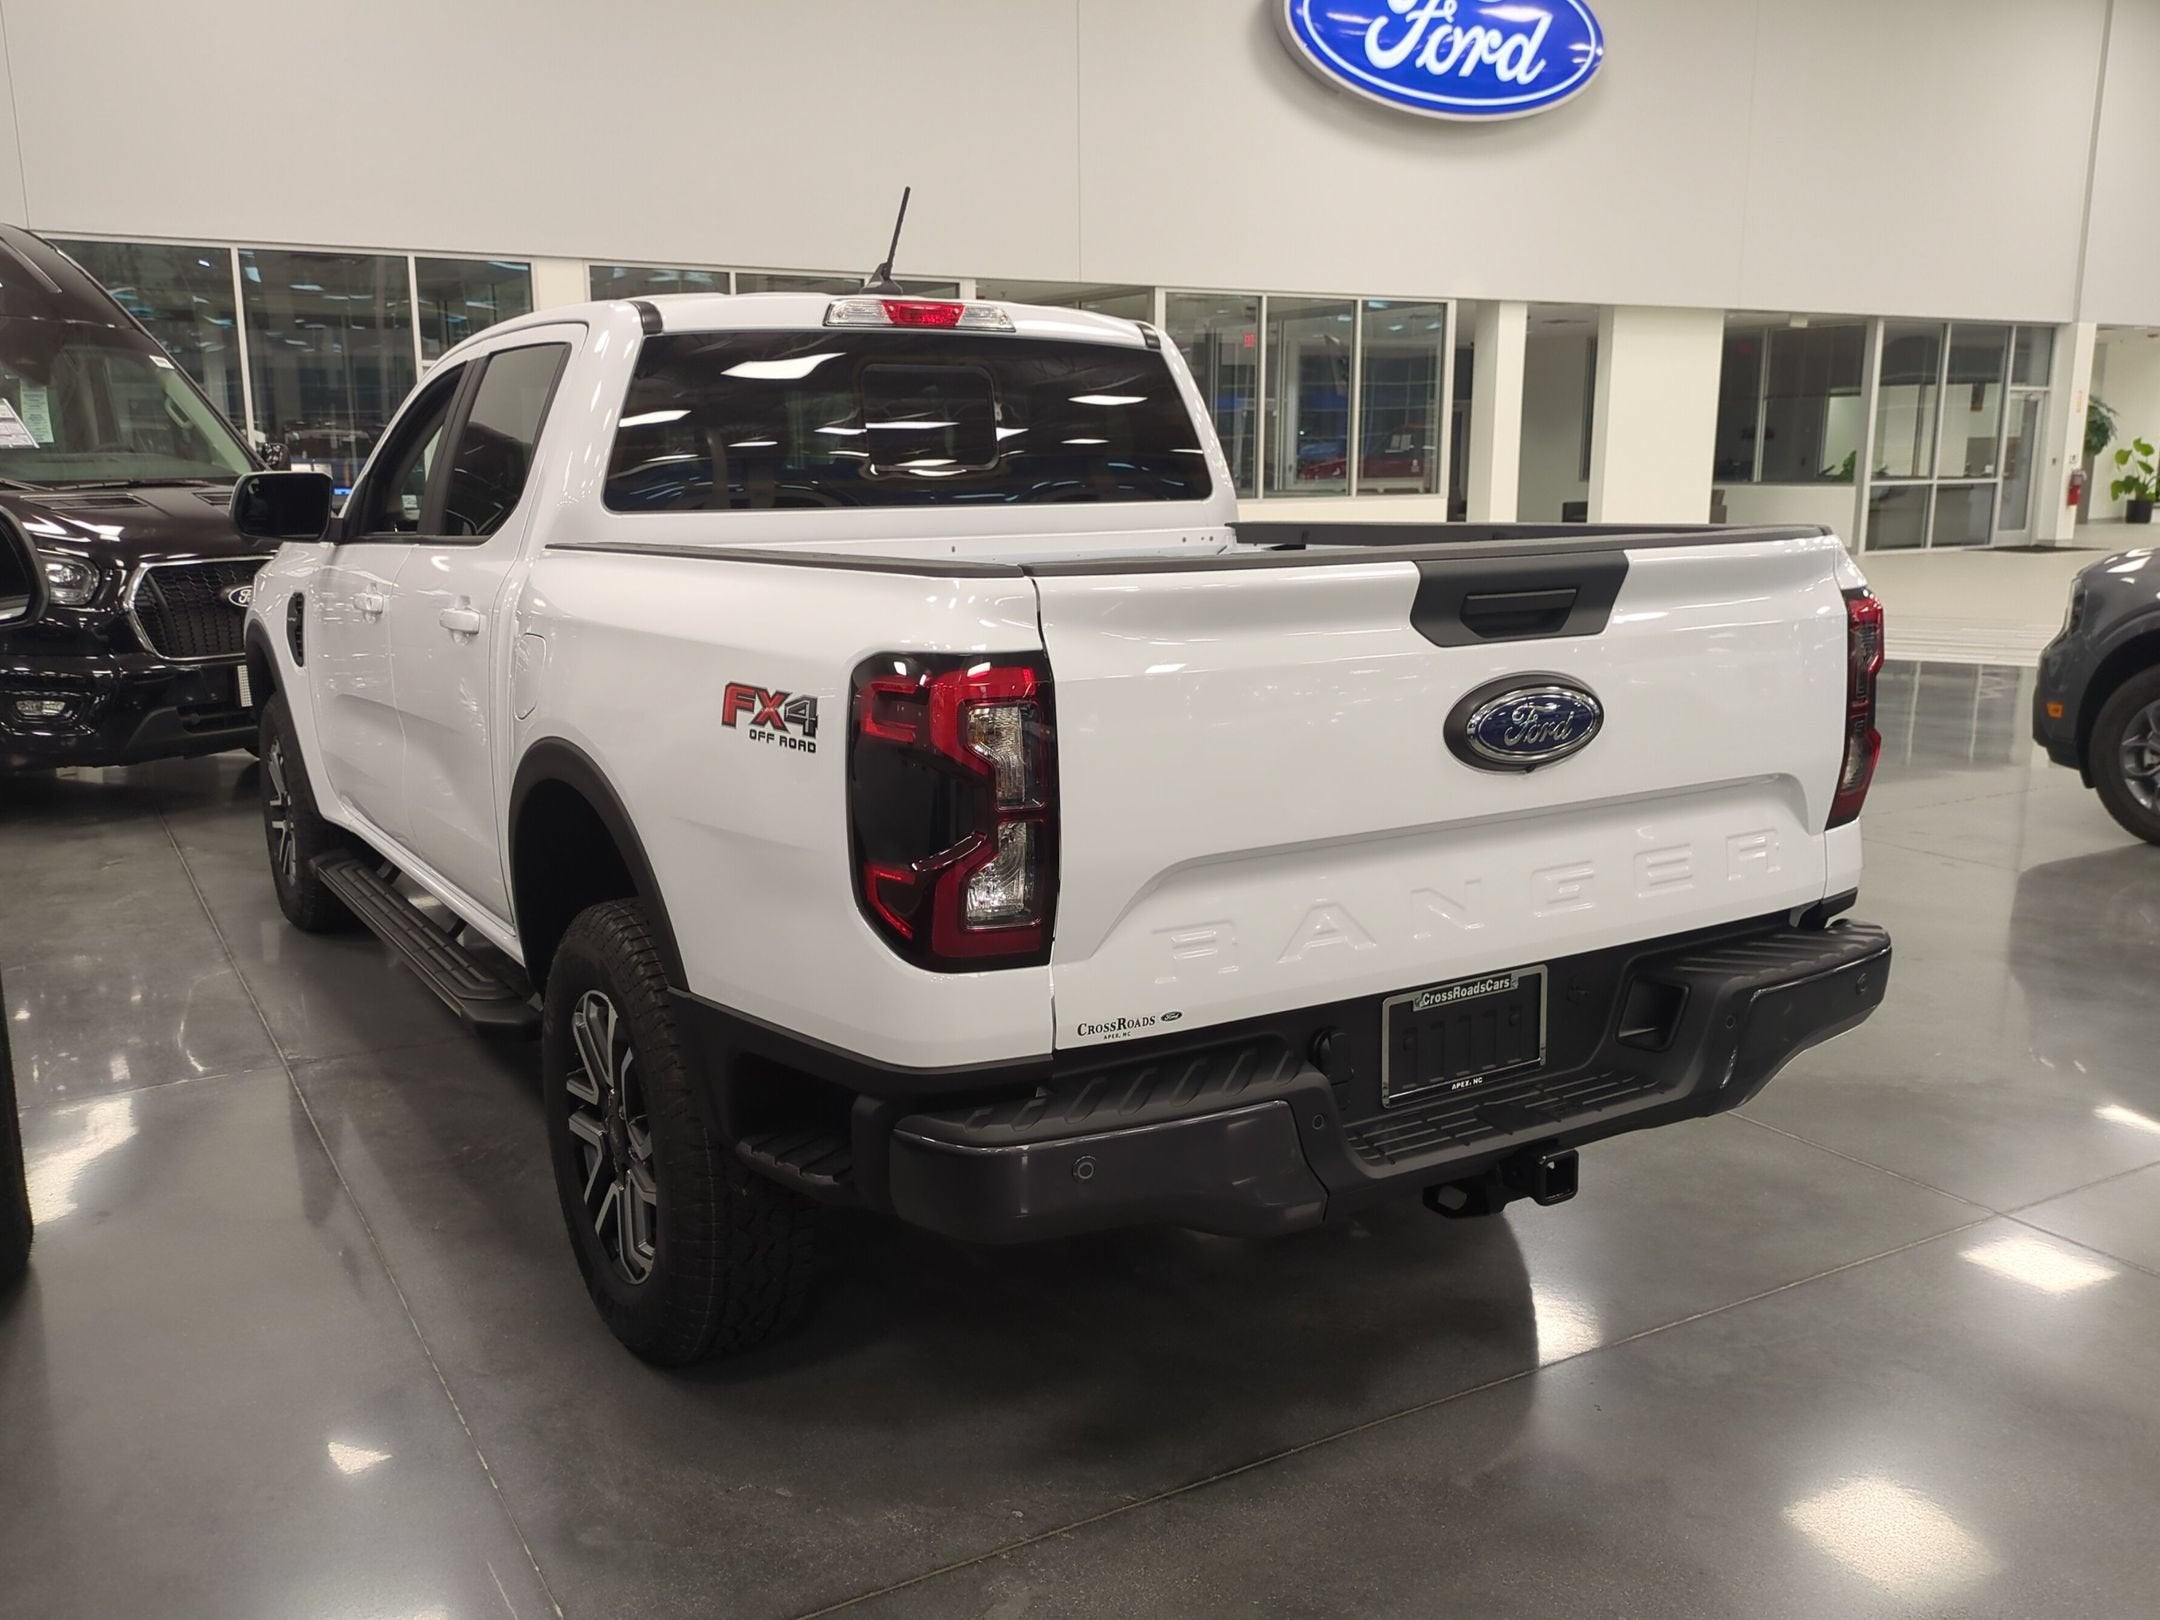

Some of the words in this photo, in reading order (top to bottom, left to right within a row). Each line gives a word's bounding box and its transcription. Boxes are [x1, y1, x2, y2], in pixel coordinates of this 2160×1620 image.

[1364, 0, 1553, 85] Ford
[721, 681, 818, 739] FX4
[1504, 702, 1575, 746] Ford
[749, 729, 775, 744] OFF
[779, 735, 816, 754] ROAD
[1151, 827, 1785, 986] RANGER
[1422, 978, 1510, 1006] CrossRoadsCars
